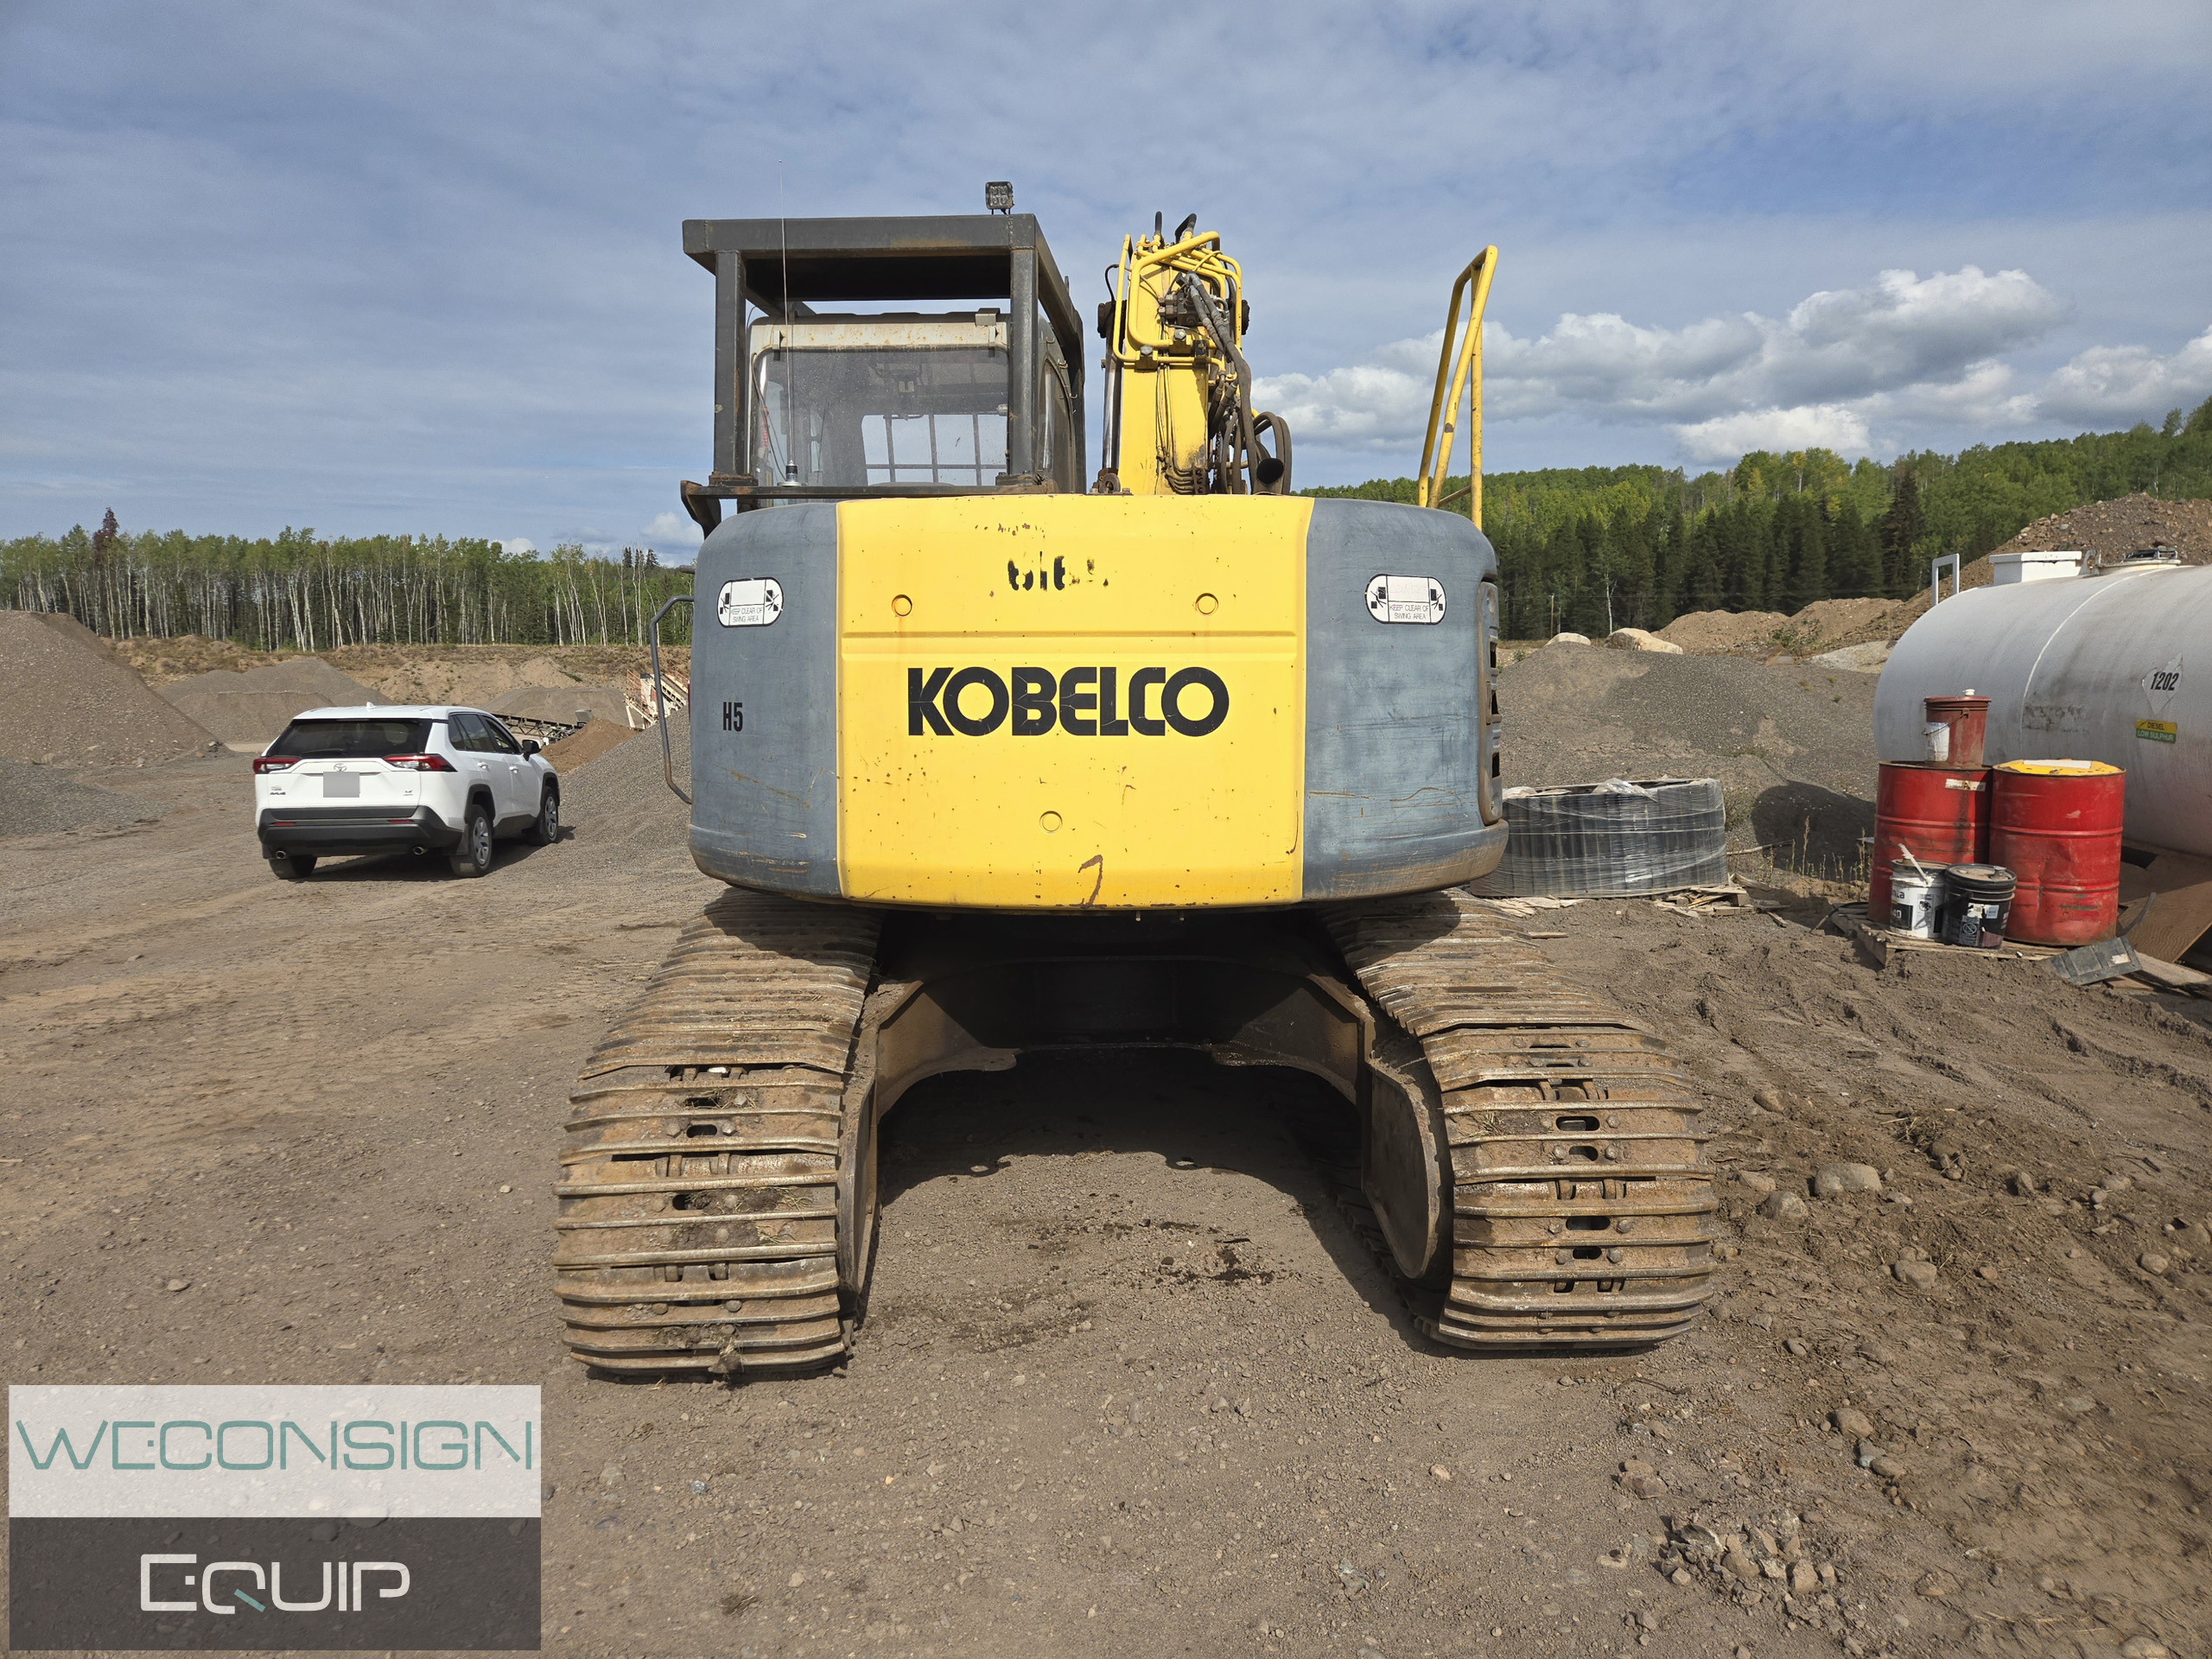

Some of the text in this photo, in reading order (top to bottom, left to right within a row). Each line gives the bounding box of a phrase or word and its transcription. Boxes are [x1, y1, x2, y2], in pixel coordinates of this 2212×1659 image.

[2150, 671, 2179, 691] 1202
[908, 666, 1230, 737] KOBELCO
[722, 702, 743, 732] H5
[2147, 721, 2164, 730] DIESEL
[2137, 729, 2174, 741] LOW SULPHUR
